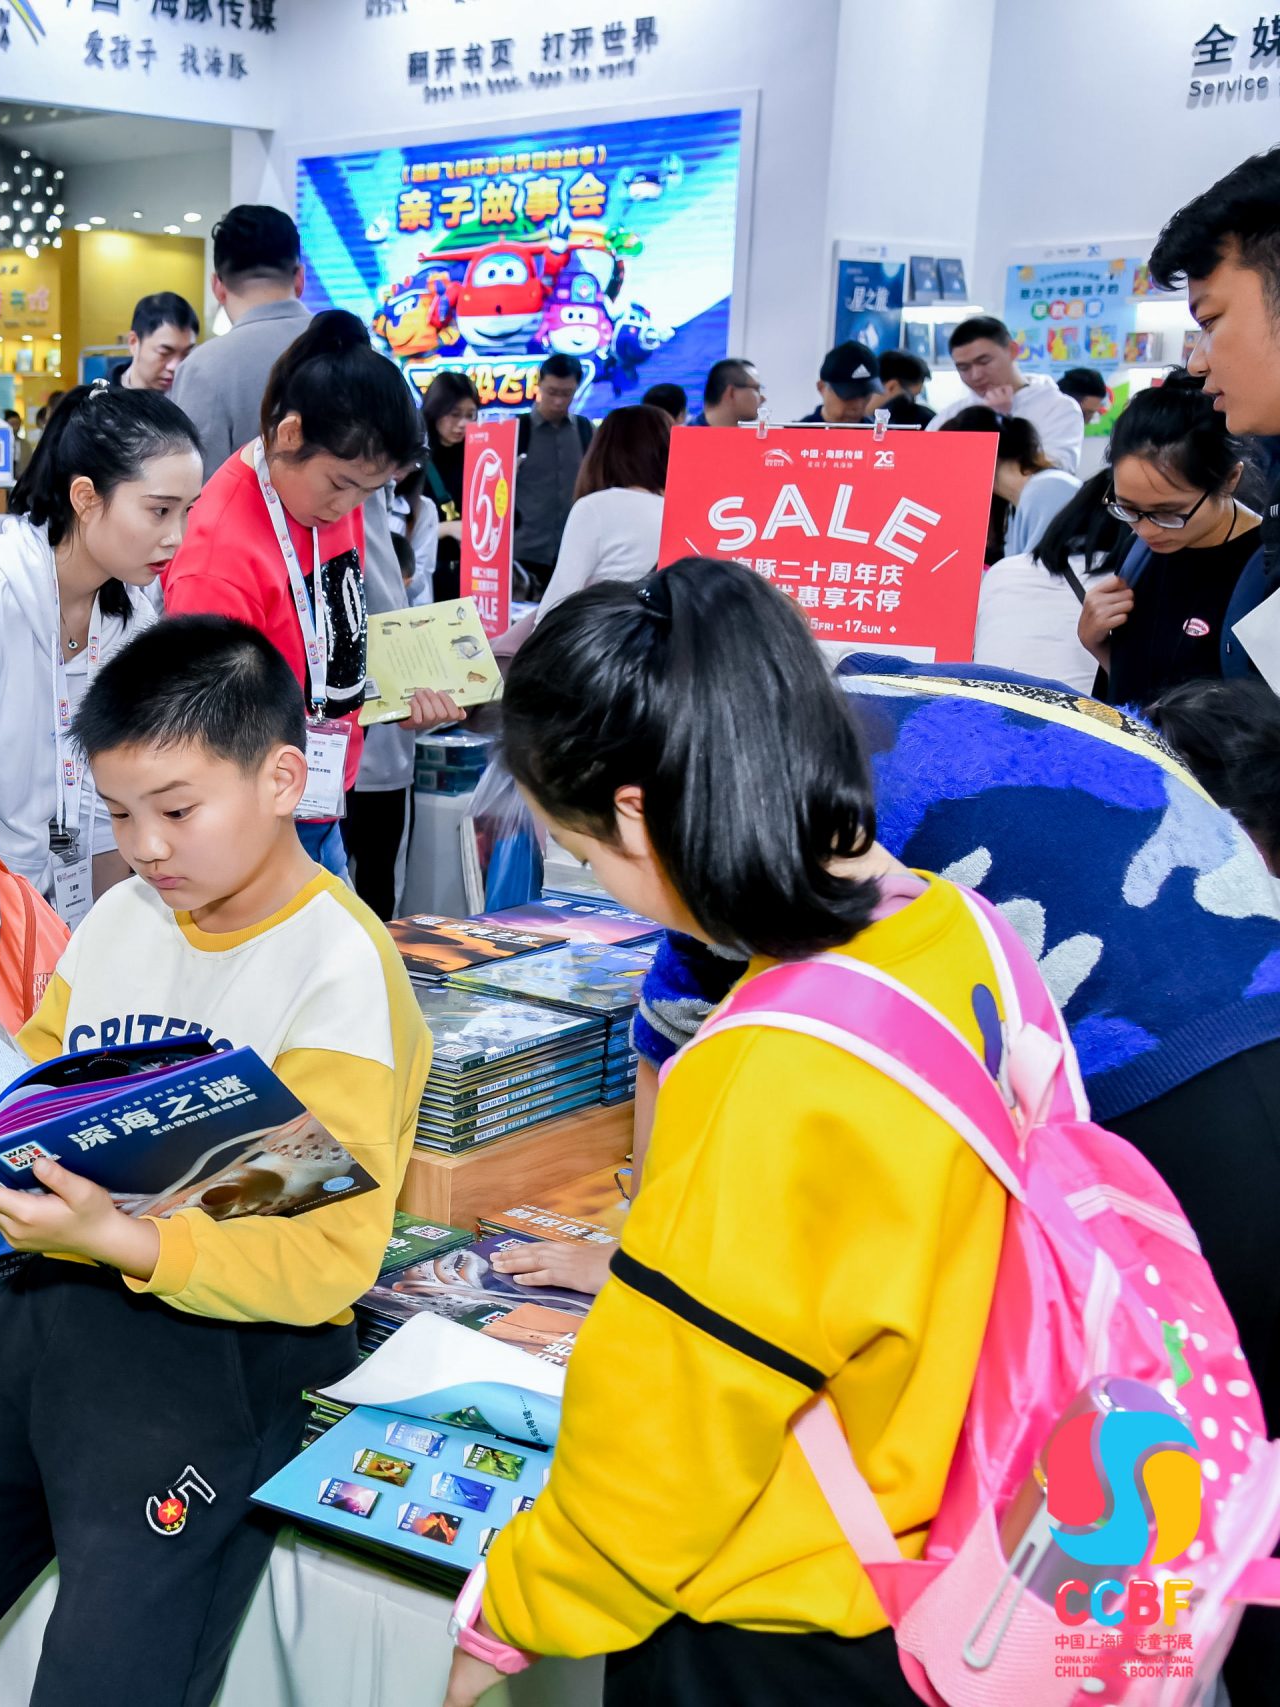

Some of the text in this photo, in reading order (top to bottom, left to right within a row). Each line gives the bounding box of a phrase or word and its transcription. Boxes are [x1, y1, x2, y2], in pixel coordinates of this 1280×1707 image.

[408, 16, 658, 80] 翻开书页 打开世界
[1188, 74, 1270, 98] Service
[399, 172, 607, 231] 亲子故事会
[708, 483, 941, 564] SALE
[68, 1075, 251, 1151] 深海之谜
[4, 1144, 35, 1158] WAS
